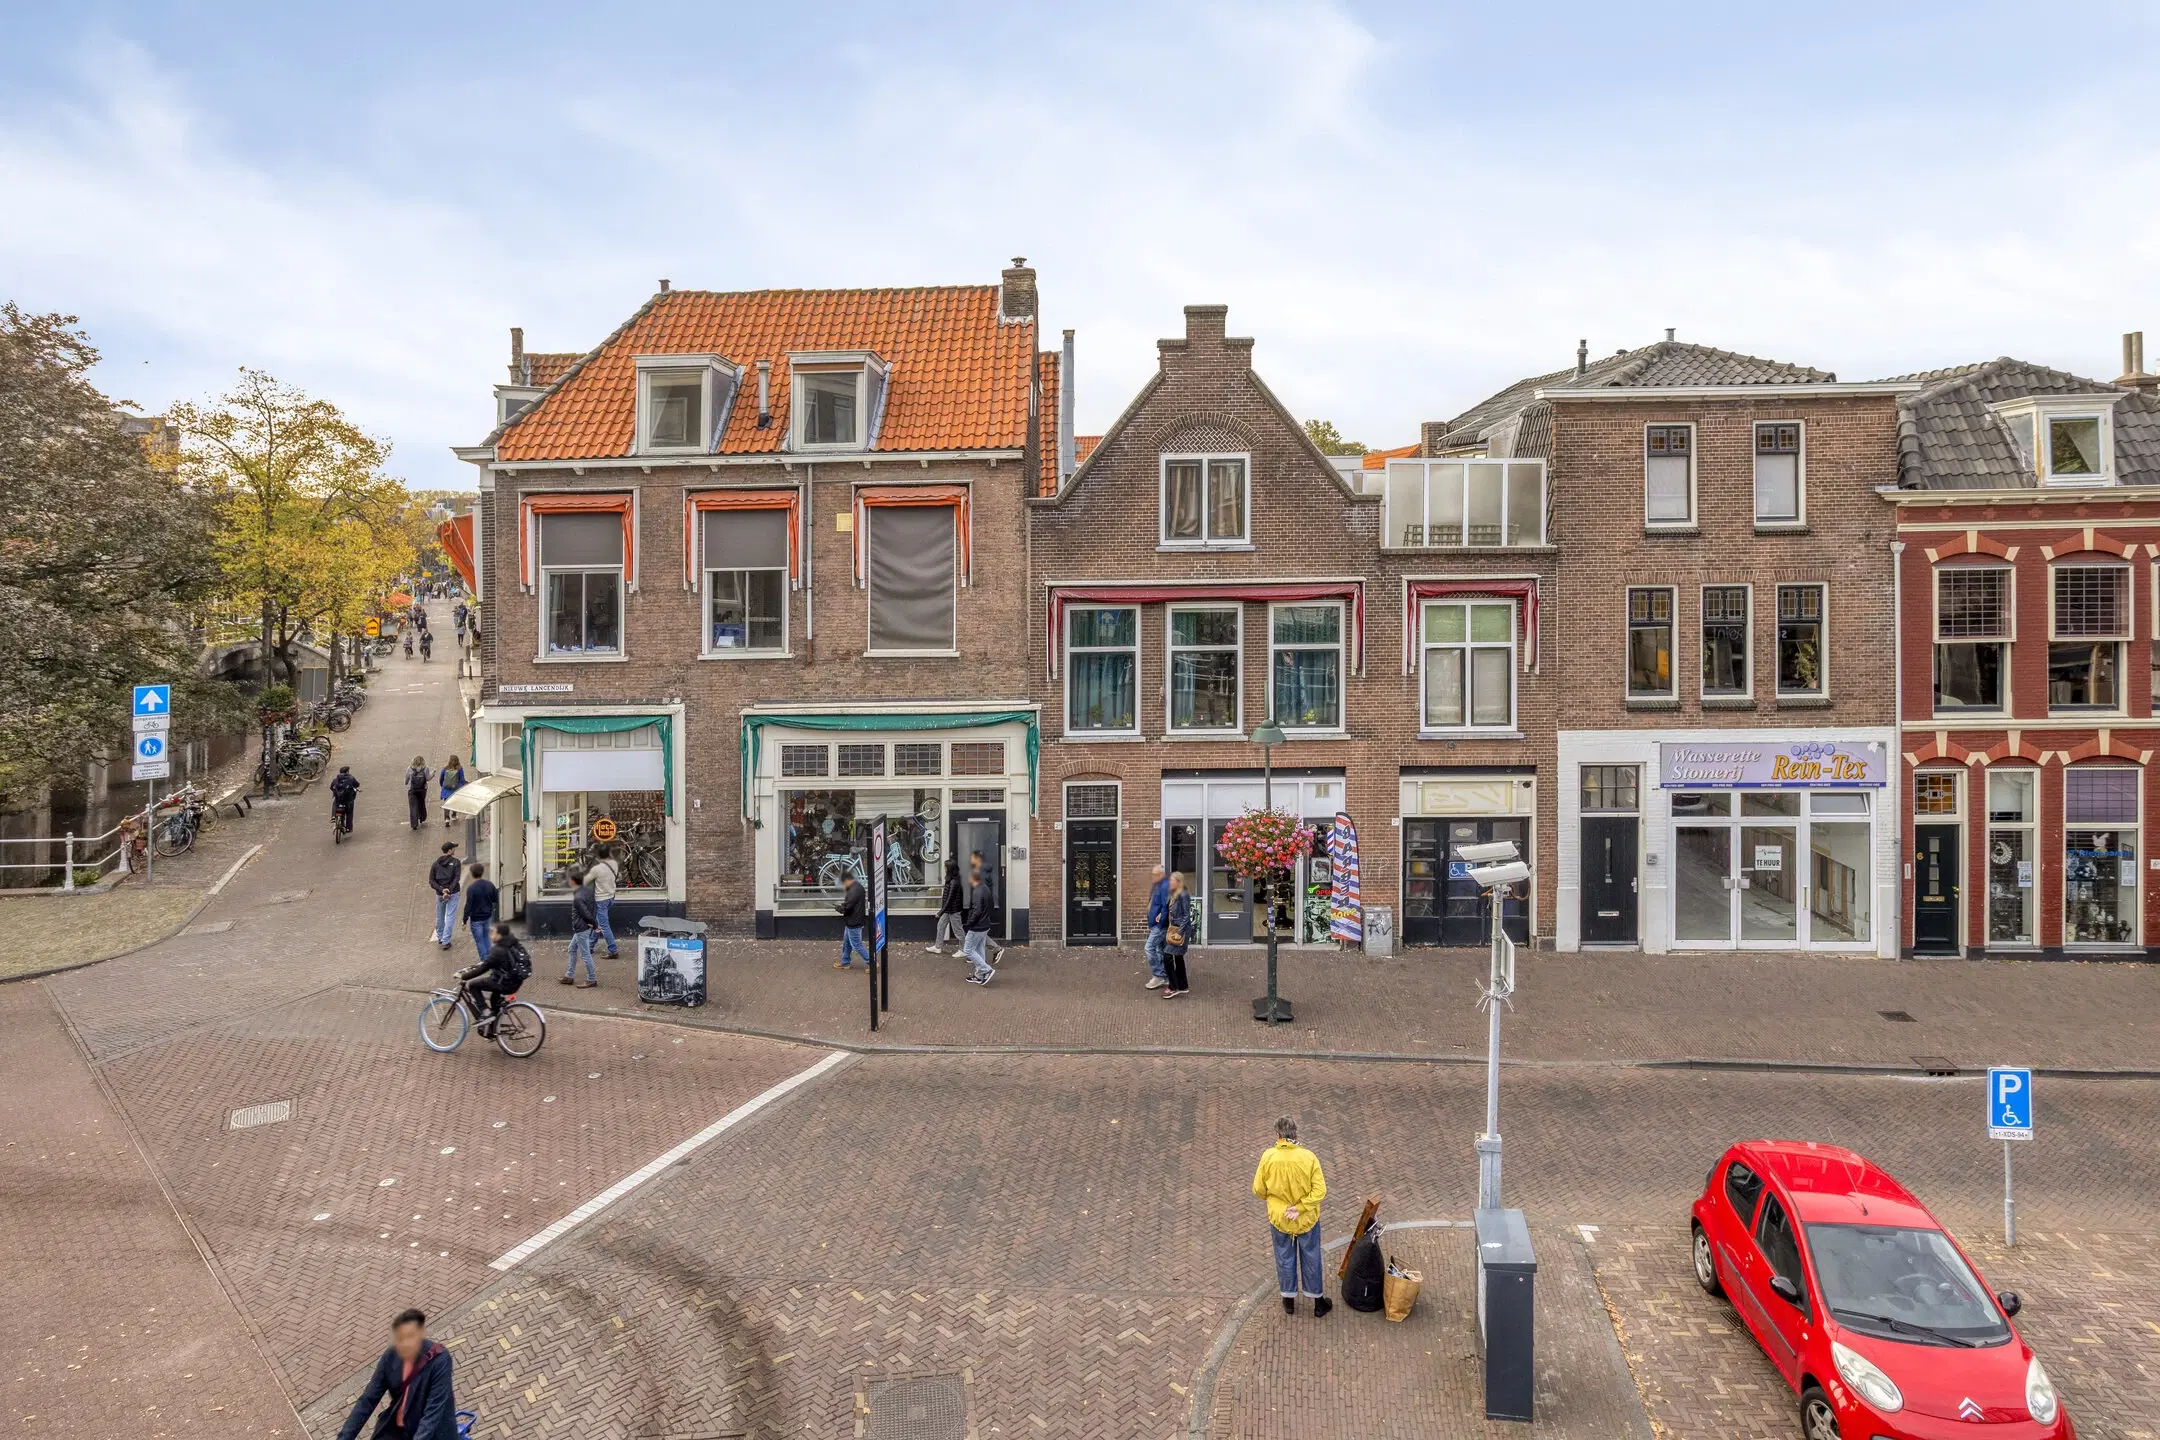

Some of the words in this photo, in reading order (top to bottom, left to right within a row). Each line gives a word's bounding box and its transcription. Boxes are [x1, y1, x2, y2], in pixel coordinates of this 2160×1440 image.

[1673, 748, 1762, 763] Wasserette
[1672, 764, 1745, 782] Stomerij
[1770, 754, 1868, 780] Rein-Tex
[1763, 859, 1781, 867] HUUR
[1999, 1073, 2022, 1104] P
